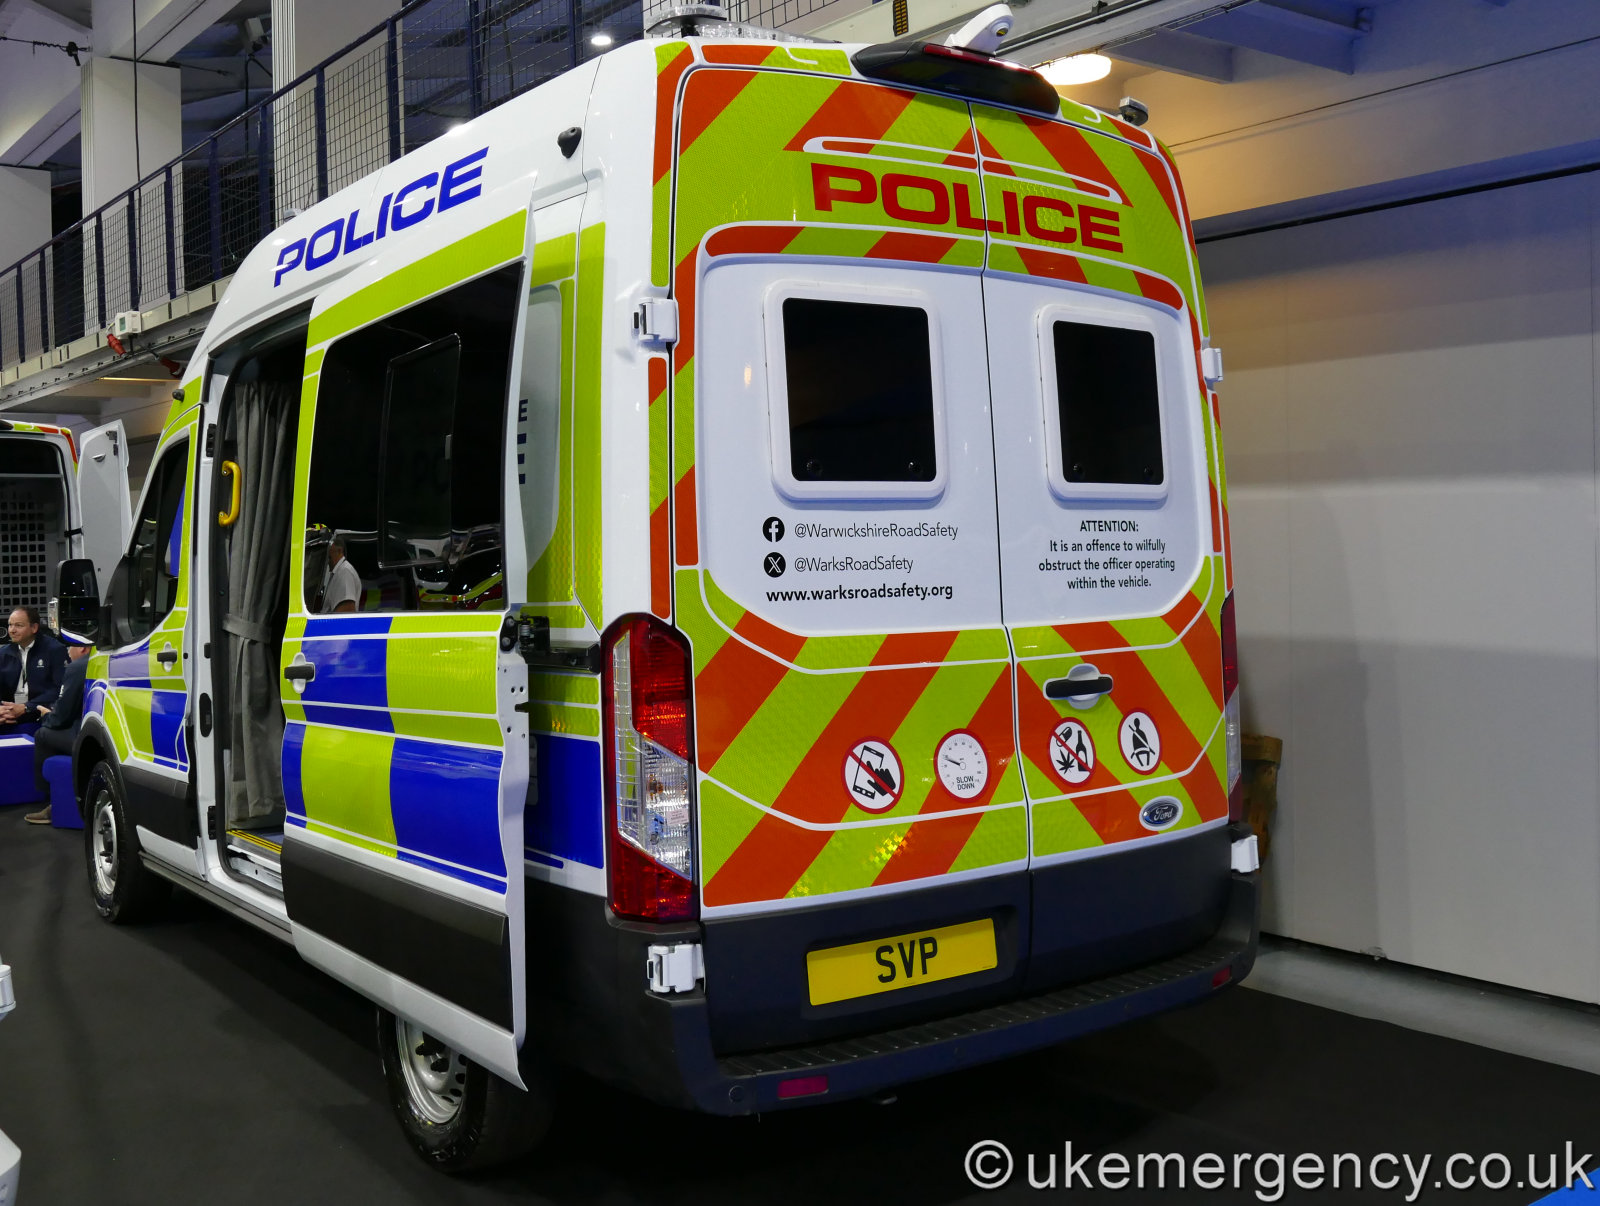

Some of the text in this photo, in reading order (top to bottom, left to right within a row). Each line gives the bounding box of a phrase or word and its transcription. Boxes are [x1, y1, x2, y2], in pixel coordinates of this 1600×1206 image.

[811, 162, 1124, 253] POLICE
[274, 146, 490, 288] POLICE
[794, 522, 959, 540] @WarwickshireRoadSafety
[1080, 520, 1139, 532] ATTENTION:
[1050, 539, 1166, 554] It is an offence to wilfully
[794, 554, 914, 573] @WarksRoadSafety
[1038, 557, 1175, 572] obstruct the officer operating
[1067, 575, 1152, 589] within the vehicle.
[766, 583, 953, 602] www.warksroadsafety.org
[956, 775, 974, 784] SLOW
[957, 783, 975, 791] DOWN
[1153, 806, 1174, 821] Ford
[875, 936, 938, 983] SVP
